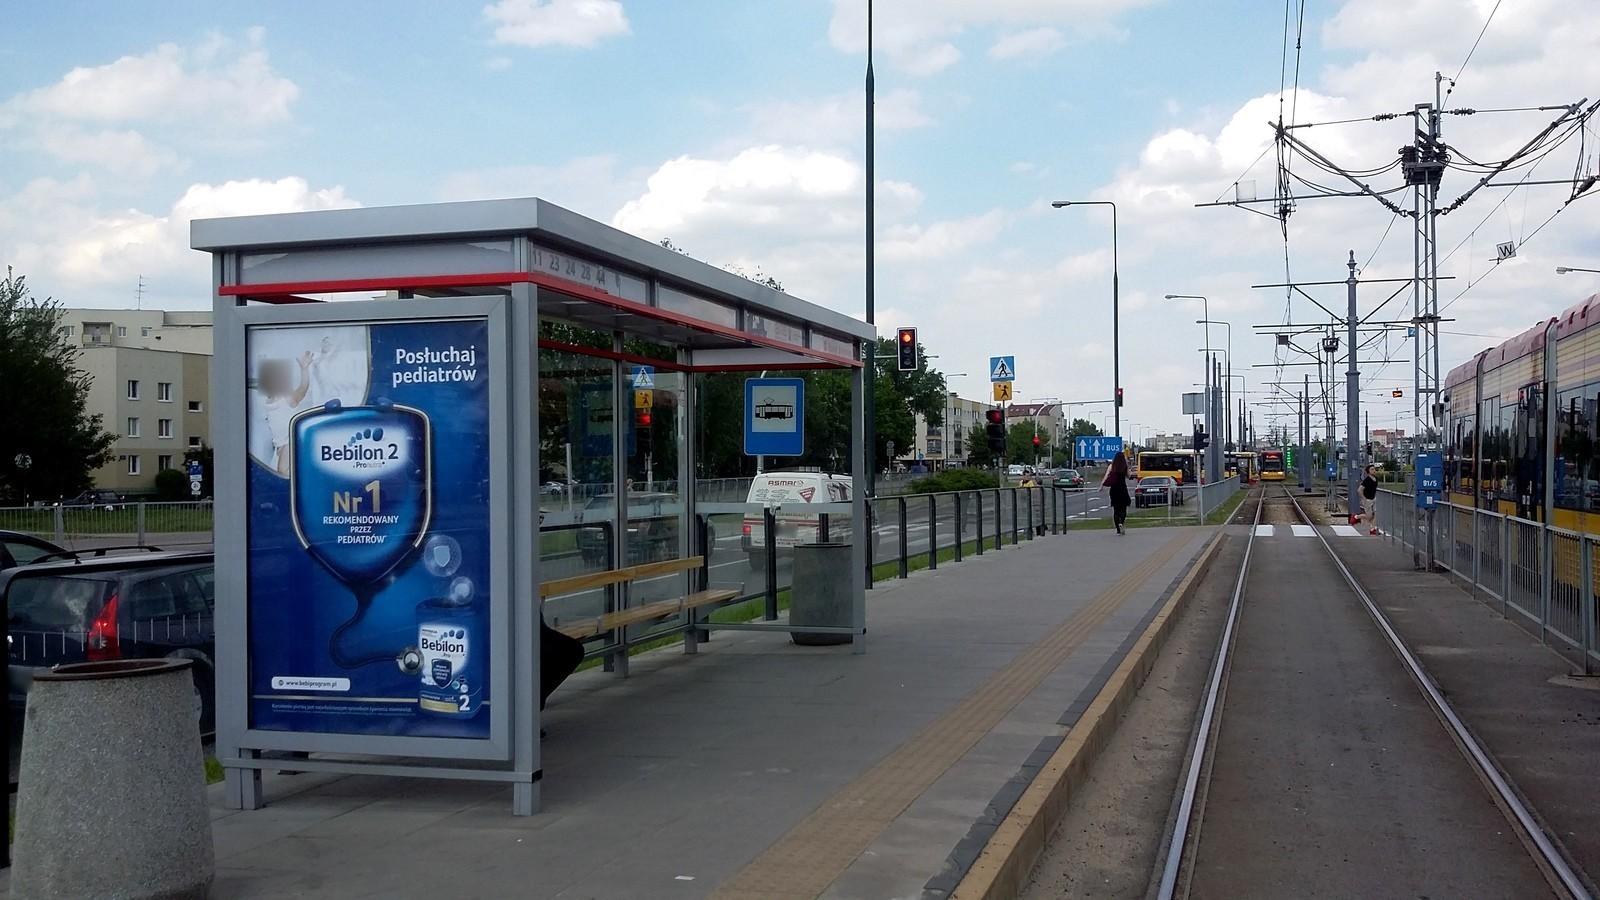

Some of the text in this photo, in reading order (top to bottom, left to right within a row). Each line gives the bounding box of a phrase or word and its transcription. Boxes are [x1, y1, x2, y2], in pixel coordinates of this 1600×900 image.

[1498, 244, 1512, 257] W
[549, 256, 560, 272] 23
[566, 260, 577, 277] 24
[580, 264, 592, 281] 28
[395, 345, 476, 367] Posłuchaj
[392, 365, 477, 388] pediatrów
[321, 443, 399, 461] Bebilon 2
[1106, 444, 1120, 452] BUS
[333, 479, 381, 514] Nr 1
[322, 515, 400, 525] REKOMENDOWANY
[350, 525, 372, 534] PRZEZ
[337, 533, 386, 545] PEDIATRÓW
[421, 638, 464, 653] Bebilon
[459, 694, 471, 711] 2
